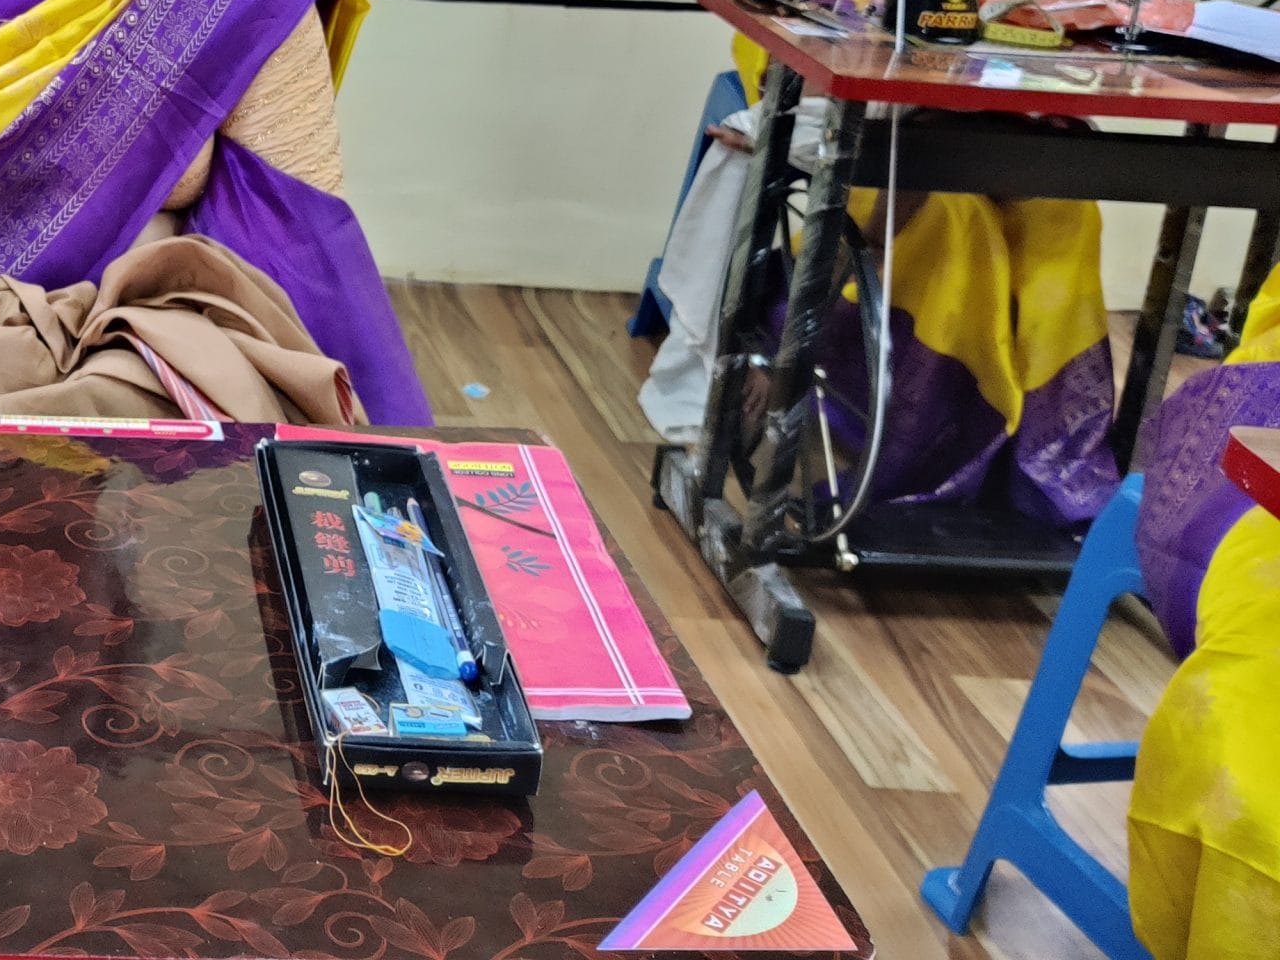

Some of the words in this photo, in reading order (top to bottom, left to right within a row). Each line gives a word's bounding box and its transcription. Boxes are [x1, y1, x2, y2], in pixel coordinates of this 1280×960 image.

[436, 767, 515, 784] JUPITER
[710, 847, 753, 888] TABLE
[703, 856, 777, 929] ADITYA
